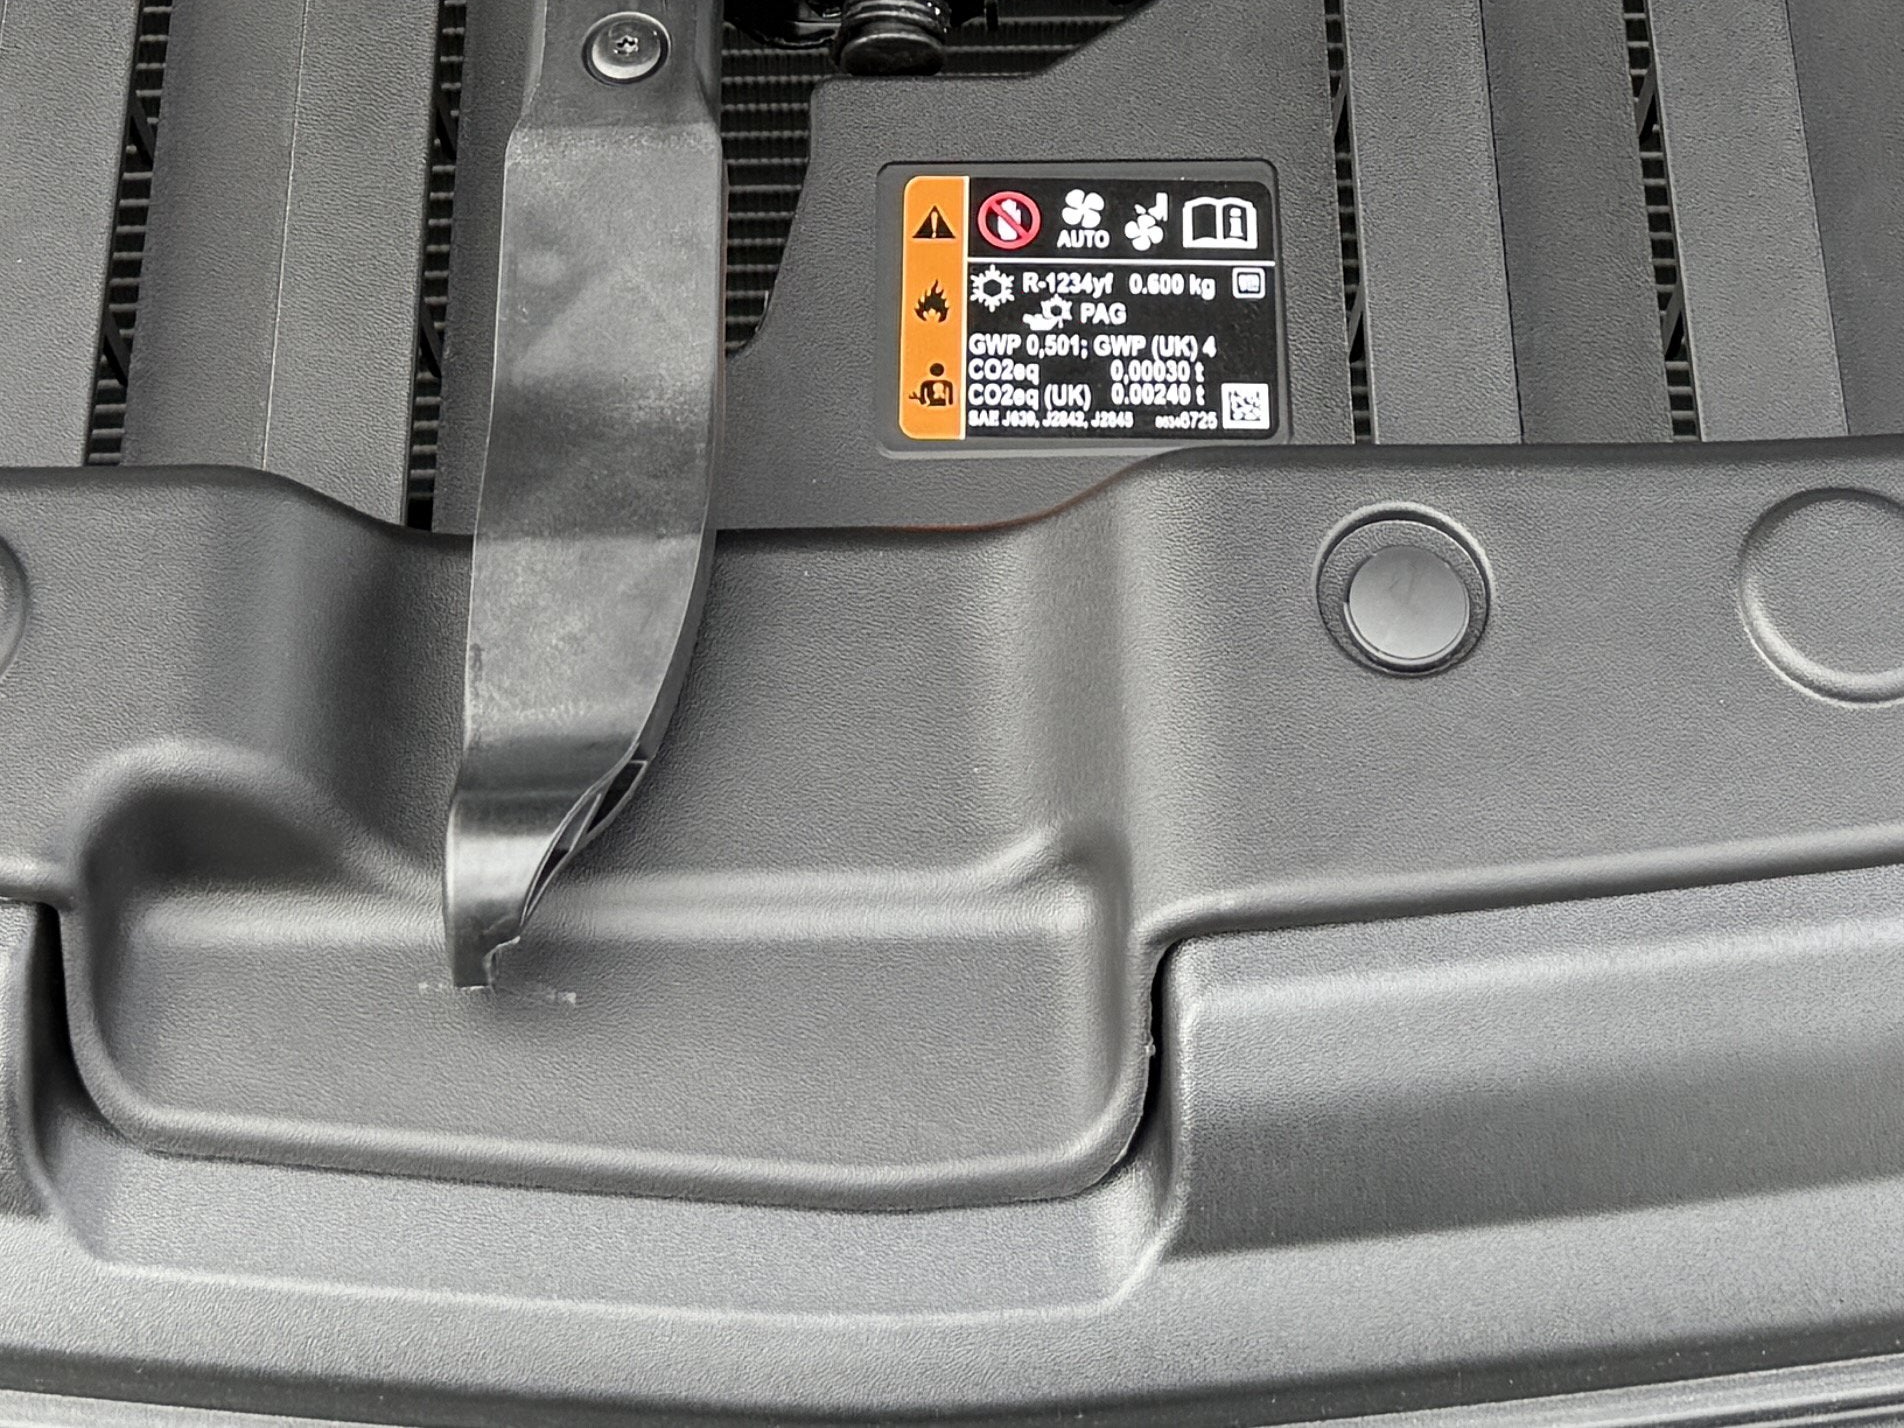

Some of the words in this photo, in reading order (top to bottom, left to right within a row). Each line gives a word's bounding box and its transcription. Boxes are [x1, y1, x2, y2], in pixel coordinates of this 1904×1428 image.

[1057, 230, 1110, 248] AUTO
[1022, 272, 1114, 298] R-1234yf
[1128, 273, 1185, 295] 0.600
[1189, 274, 1216, 300] kg
[1080, 303, 1127, 325] PAG
[968, 333, 1022, 356] GWP
[1026, 334, 1088, 359] 0,501;
[1093, 335, 1147, 357] GWP
[1151, 335, 1199, 362] (UK)
[1202, 336, 1217, 358] 4
[968, 358, 1040, 382] CO2eq
[1194, 362, 1205, 382] t
[968, 383, 1039, 410] CO2eq
[1044, 383, 1092, 410] (UK)
[1195, 385, 1205, 406] t
